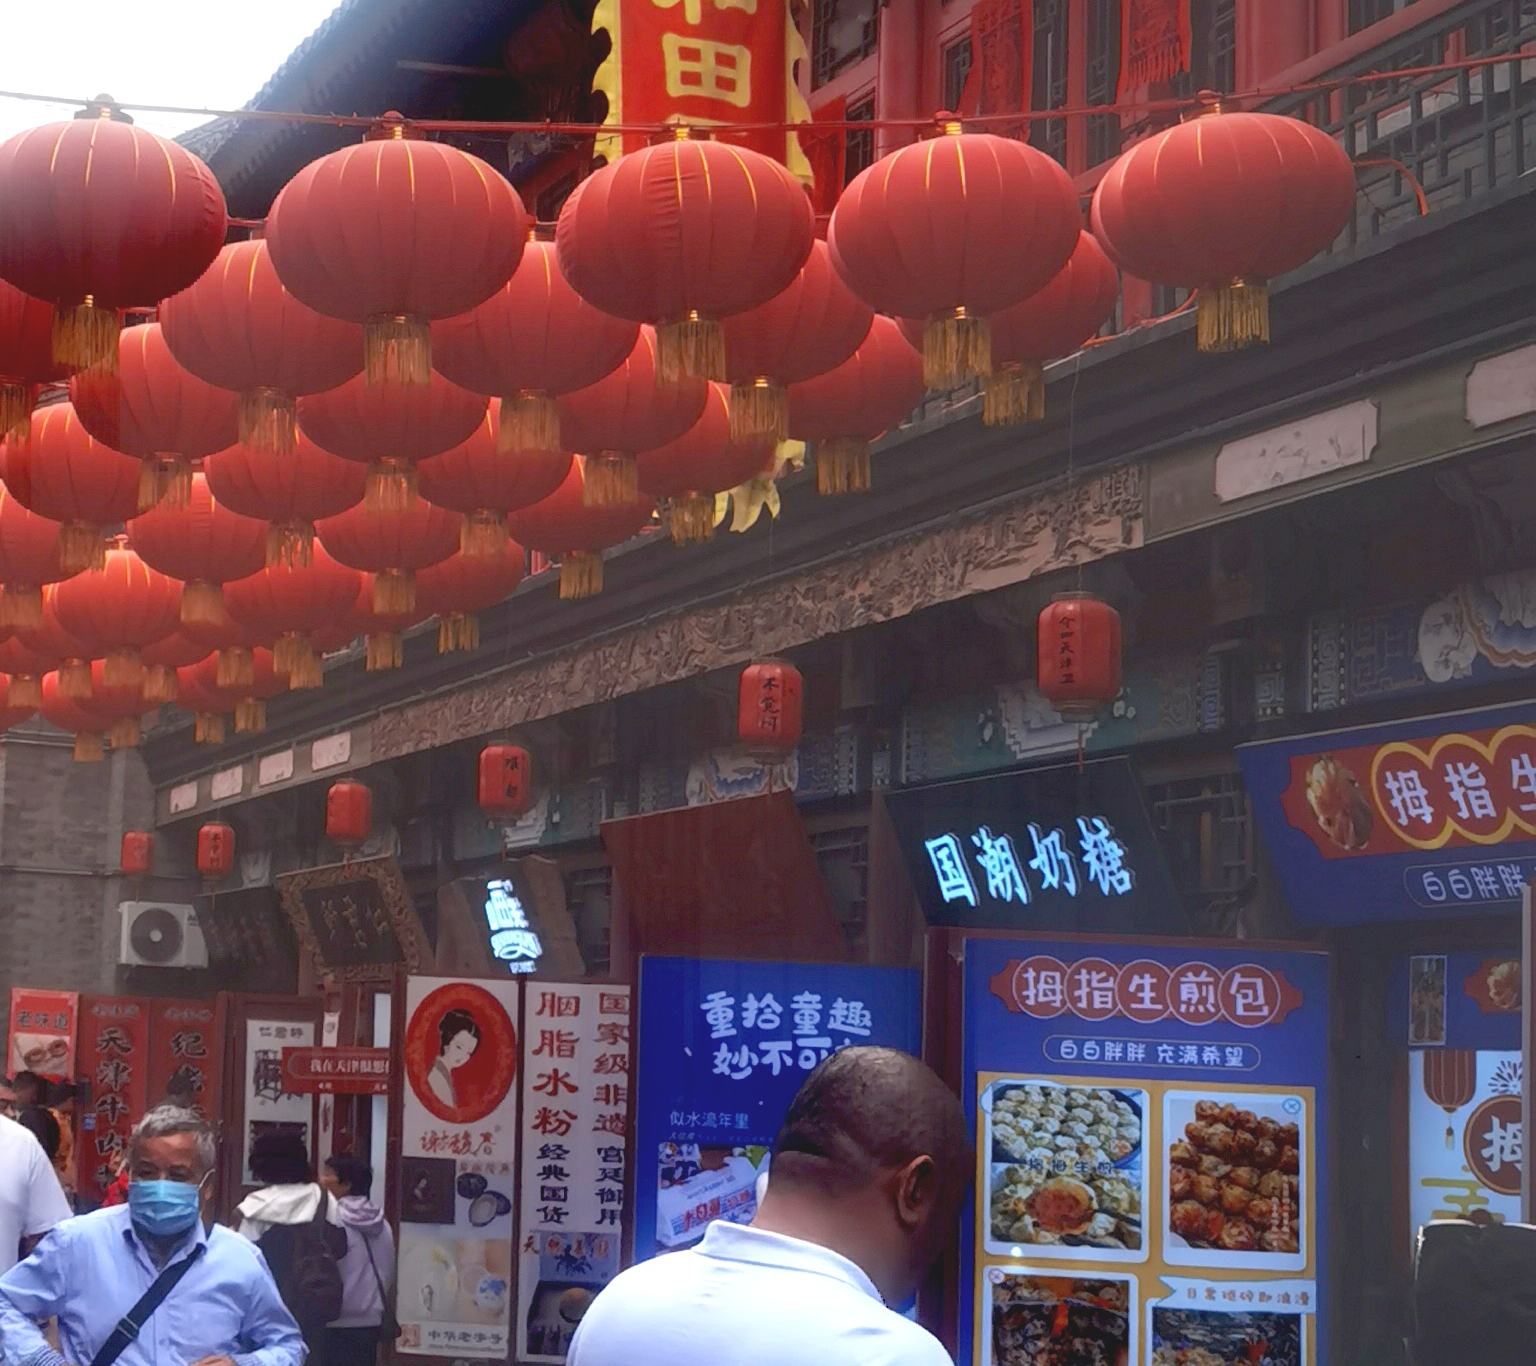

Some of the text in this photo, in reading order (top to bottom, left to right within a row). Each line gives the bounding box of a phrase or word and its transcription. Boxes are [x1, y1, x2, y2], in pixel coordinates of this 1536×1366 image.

[924, 815, 1134, 907] 国潮奶糖
[700, 990, 872, 1039] 重拾童趣
[1022, 967, 1269, 1017] 拇指生煎包
[532, 992, 580, 1137] 胭脂水粉
[592, 993, 630, 1137] 国家级非遗
[713, 1036, 852, 1080] 妙不可
[1060, 1039, 1244, 1067] 白白胖胖 充满希望
[537, 1143, 570, 1224] 经典国货
